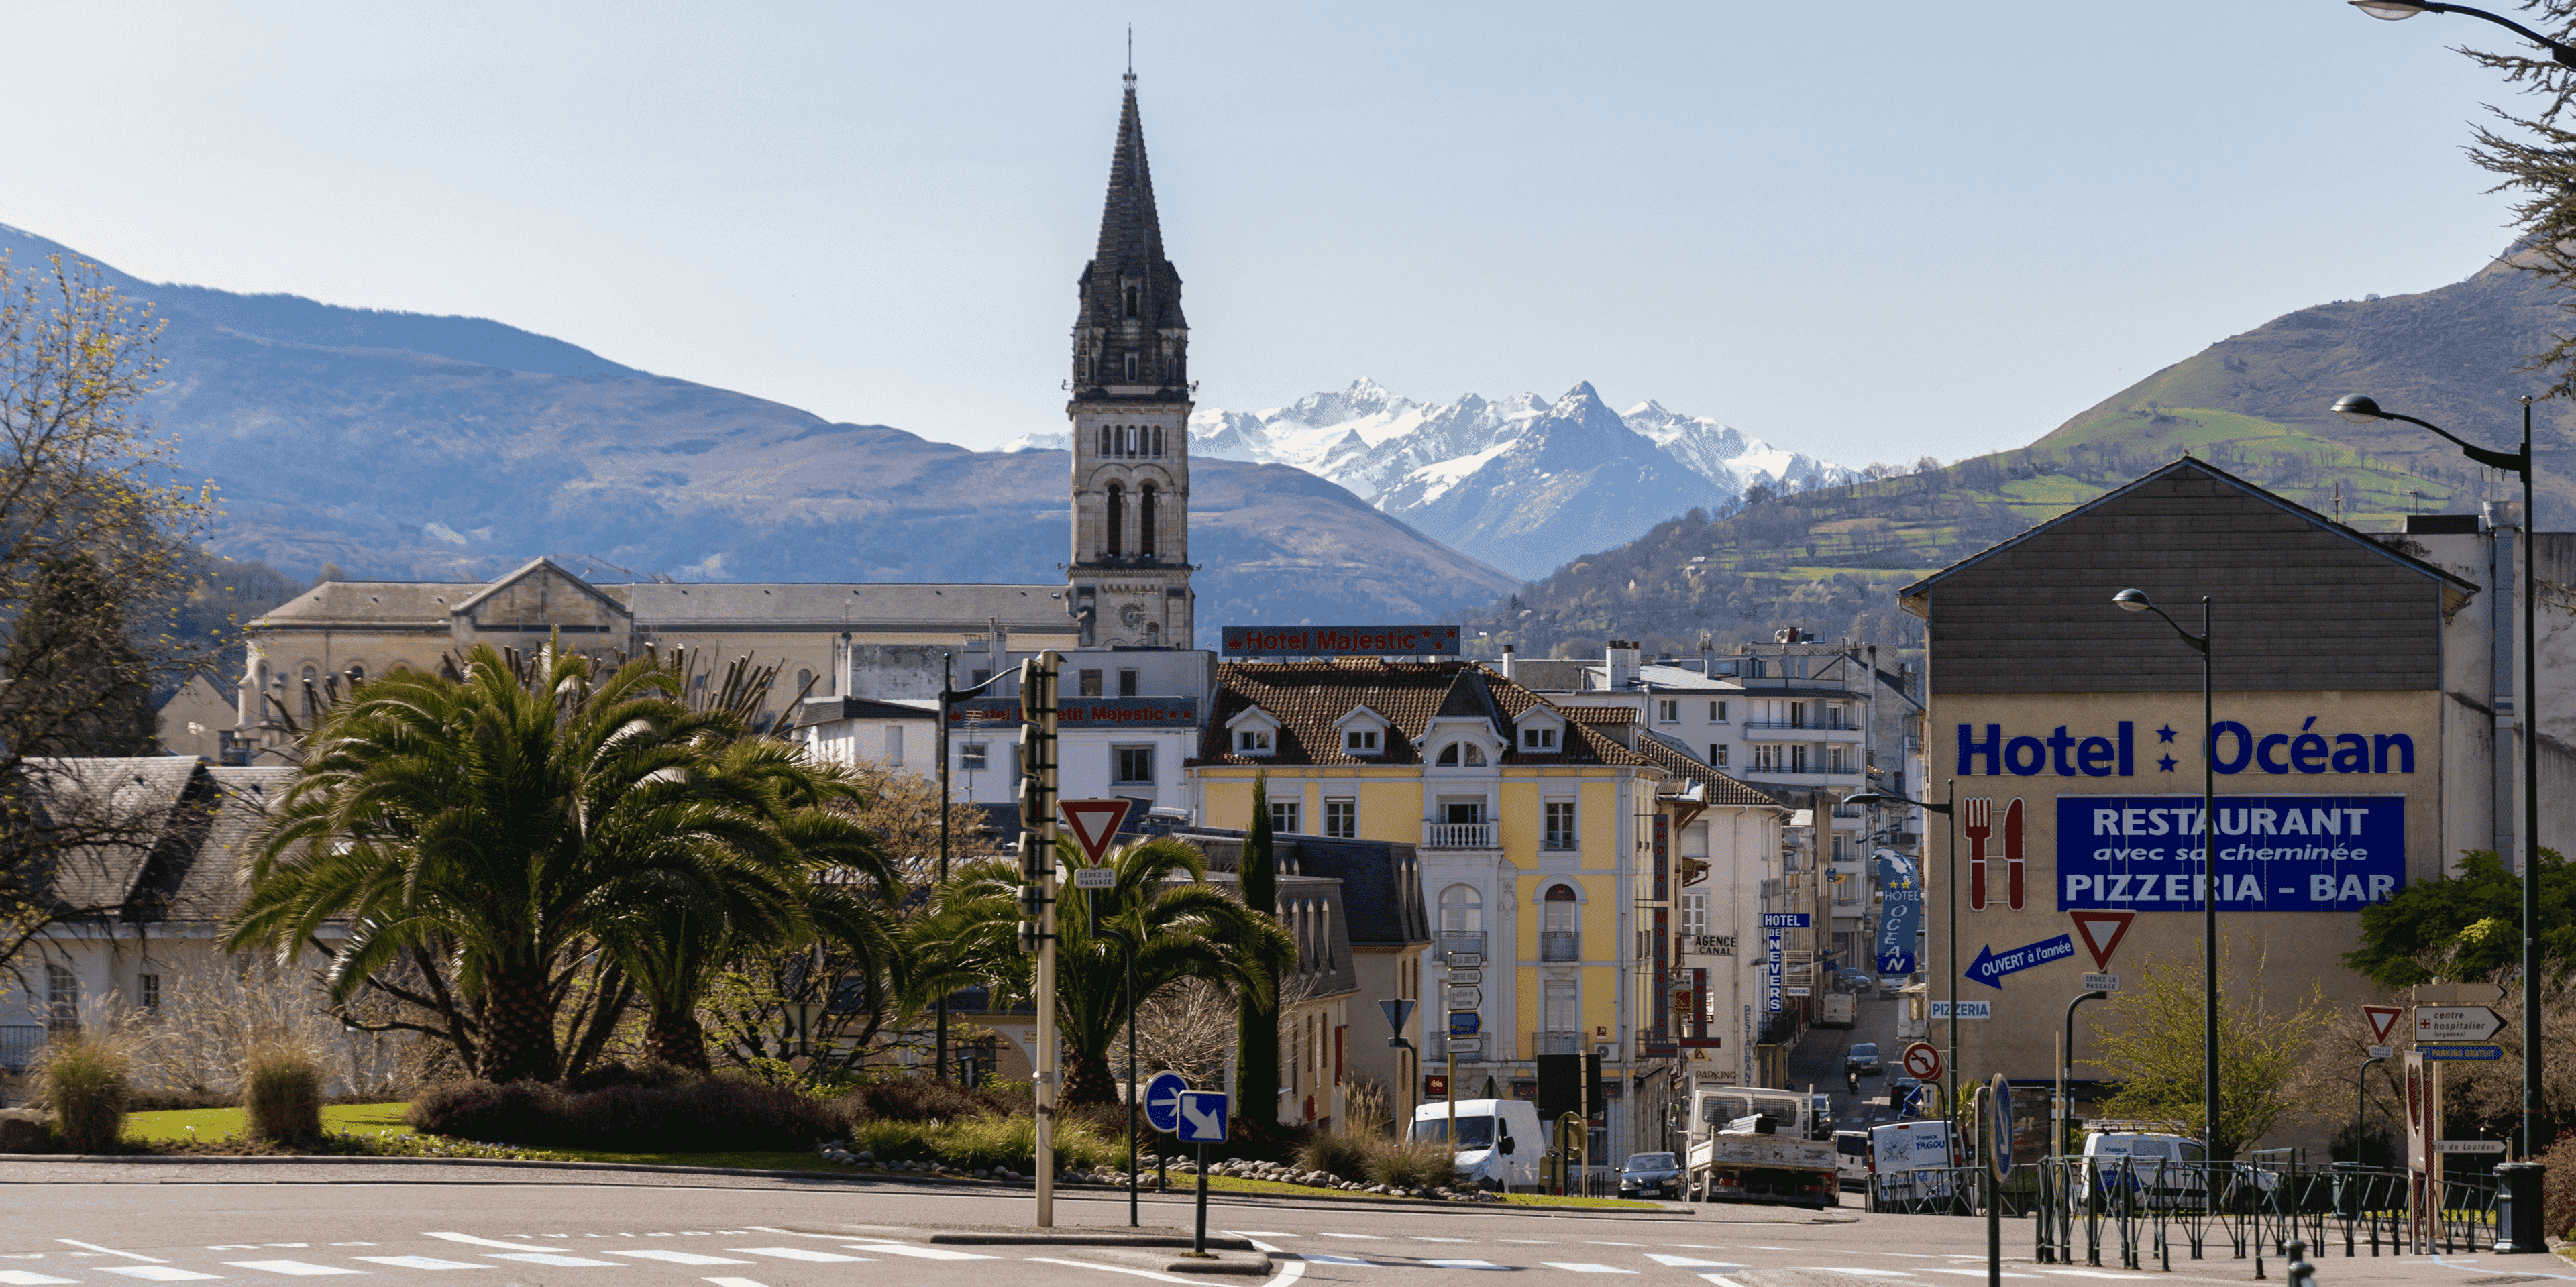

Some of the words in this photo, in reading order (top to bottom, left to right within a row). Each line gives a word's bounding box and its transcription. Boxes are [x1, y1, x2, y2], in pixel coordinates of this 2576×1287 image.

[1246, 630, 1307, 651] Hotel
[1316, 629, 1417, 653] Majestic
[966, 707, 1011, 721] Hotel
[1057, 707, 1084, 721] etit
[1091, 706, 1165, 724] Majestic
[1956, 720, 2134, 777] Hotel
[2202, 716, 2414, 775] Océan
[2093, 807, 2369, 836] RESTAURANT
[2093, 848, 2165, 861] avec
[2174, 848, 2207, 861] sa
[2219, 842, 2368, 861] cheminée
[1656, 830, 1666, 899] Hotel
[1079, 871, 1102, 879] CÉDEZ
[1884, 890, 1920, 901] HOTEL
[2066, 873, 2264, 901] PIZZERIA
[2310, 873, 2395, 901] BAR
[1764, 914, 1801, 926] HOTEL
[1695, 935, 1737, 947] AGENCE
[1768, 928, 1781, 937] DE
[1883, 904, 1908, 972] OCEAN
[1699, 946, 1733, 956] CANAL
[1981, 952, 2025, 976] OUVERT
[2027, 949, 2035, 963] à
[2035, 940, 2072, 960] l'année
[1452, 972, 1466, 981] CENTRE
[1655, 910, 1666, 1029] Majestic
[1769, 938, 1781, 1010] NEVERS
[1695, 970, 1705, 1036] Hotel
[2434, 1021, 2485, 1031] hospitalier
[2432, 1049, 2463, 1058] PARKING
[2465, 1049, 2495, 1058] GRATUIT
[1695, 1070, 1736, 1080] PARKING
[1915, 1140, 1945, 1150] FAGOU
